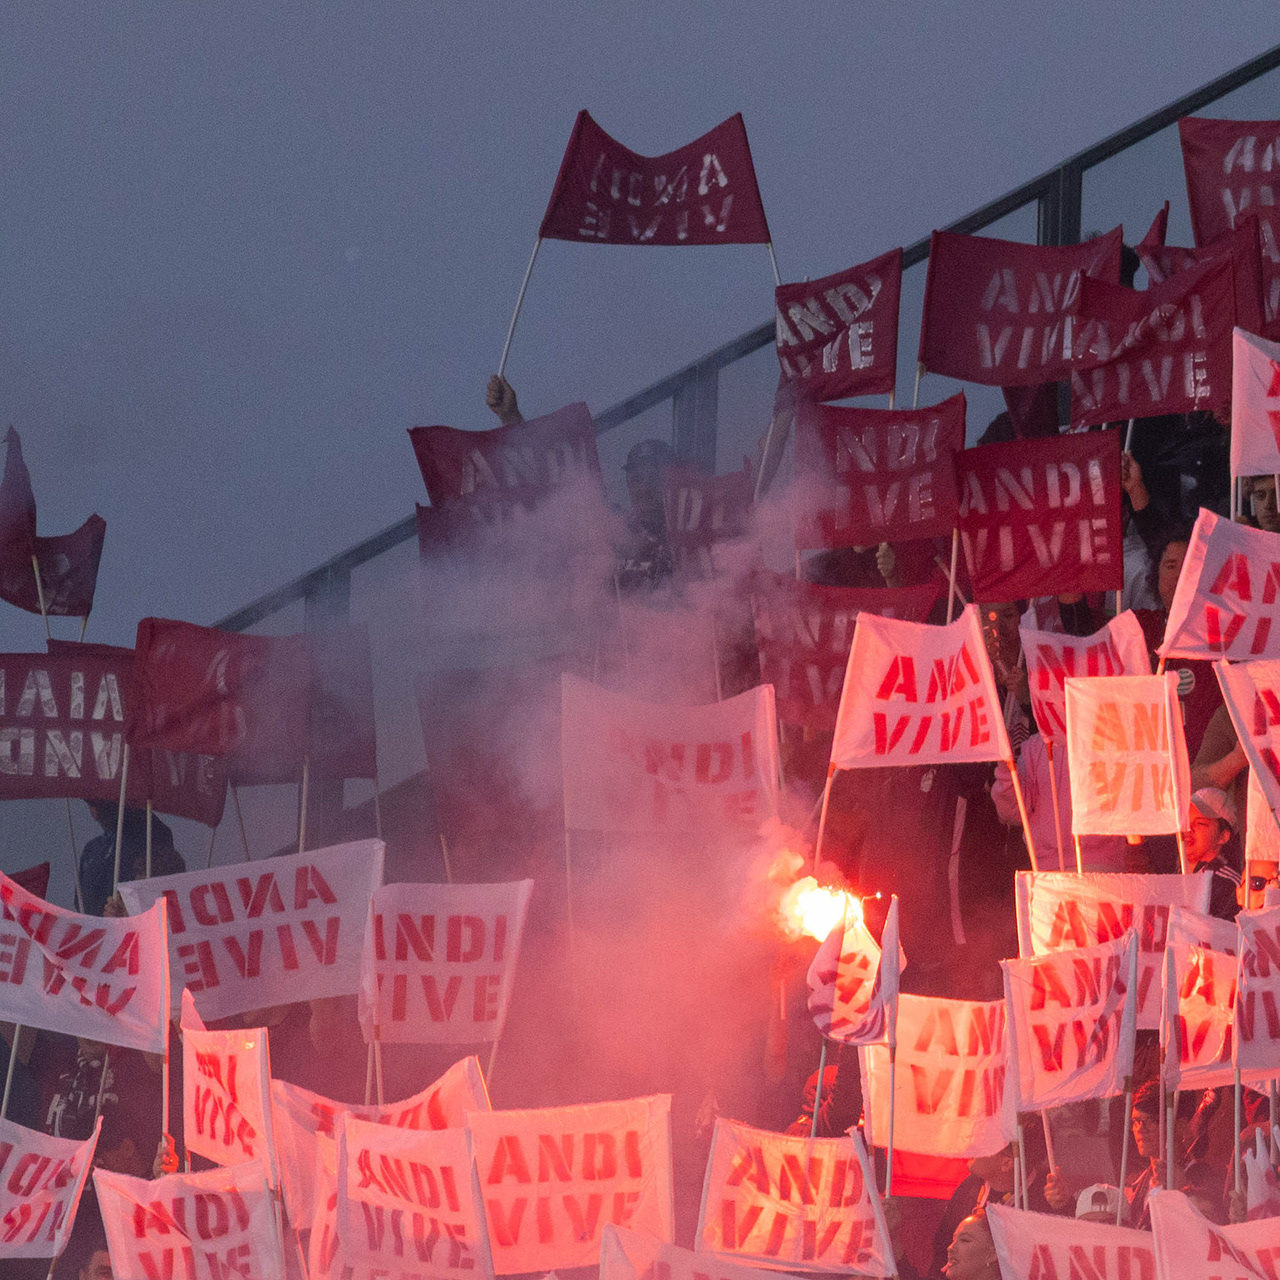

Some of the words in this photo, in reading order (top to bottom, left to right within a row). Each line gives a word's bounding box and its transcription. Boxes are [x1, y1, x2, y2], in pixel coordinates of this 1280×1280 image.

[838, 419, 940, 472] NDI
[960, 458, 1108, 518] ANDI
[962, 518, 1110, 575] VIVE
[876, 642, 980, 702] ANDI
[874, 699, 990, 756] VIVE
[374, 914, 505, 962] NDI
[374, 974, 499, 1022] IVE
[358, 1148, 459, 1212] ANDI
[488, 1130, 642, 1184] ANDI
[360, 1200, 475, 1271] VIVE
